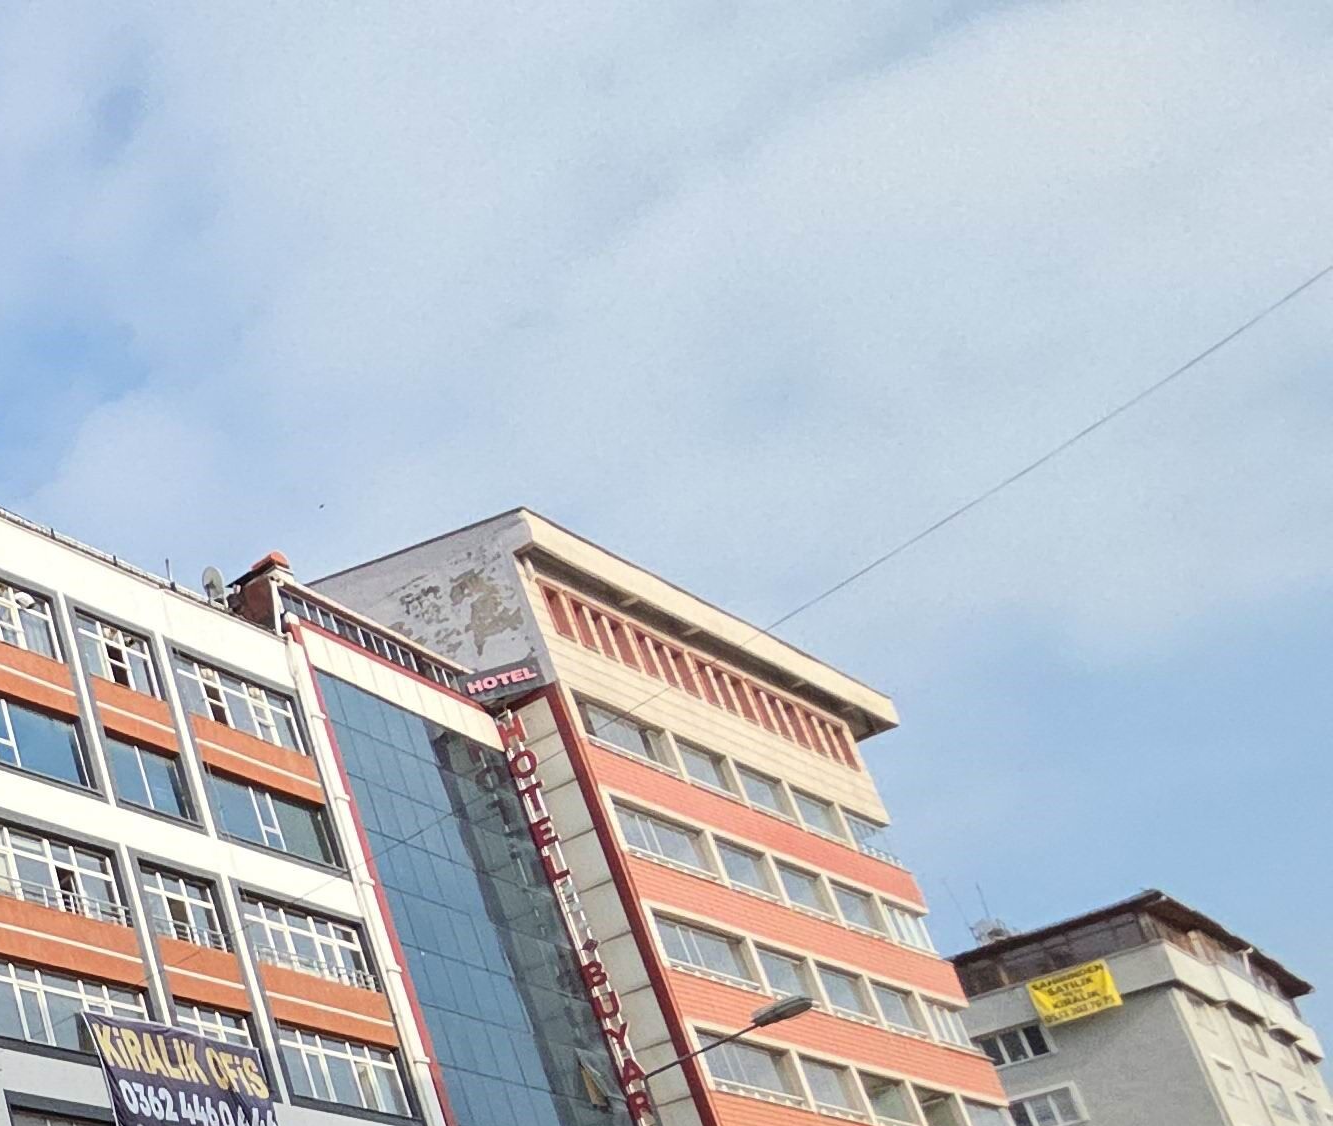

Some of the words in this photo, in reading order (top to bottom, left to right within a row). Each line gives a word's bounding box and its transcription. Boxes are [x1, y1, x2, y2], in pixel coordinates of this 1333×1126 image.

[466, 667, 538, 694] HOTEL
[497, 713, 571, 883] HOTEL
[581, 960, 652, 1120] BUYAR
[118, 1079, 180, 1122] 0362
